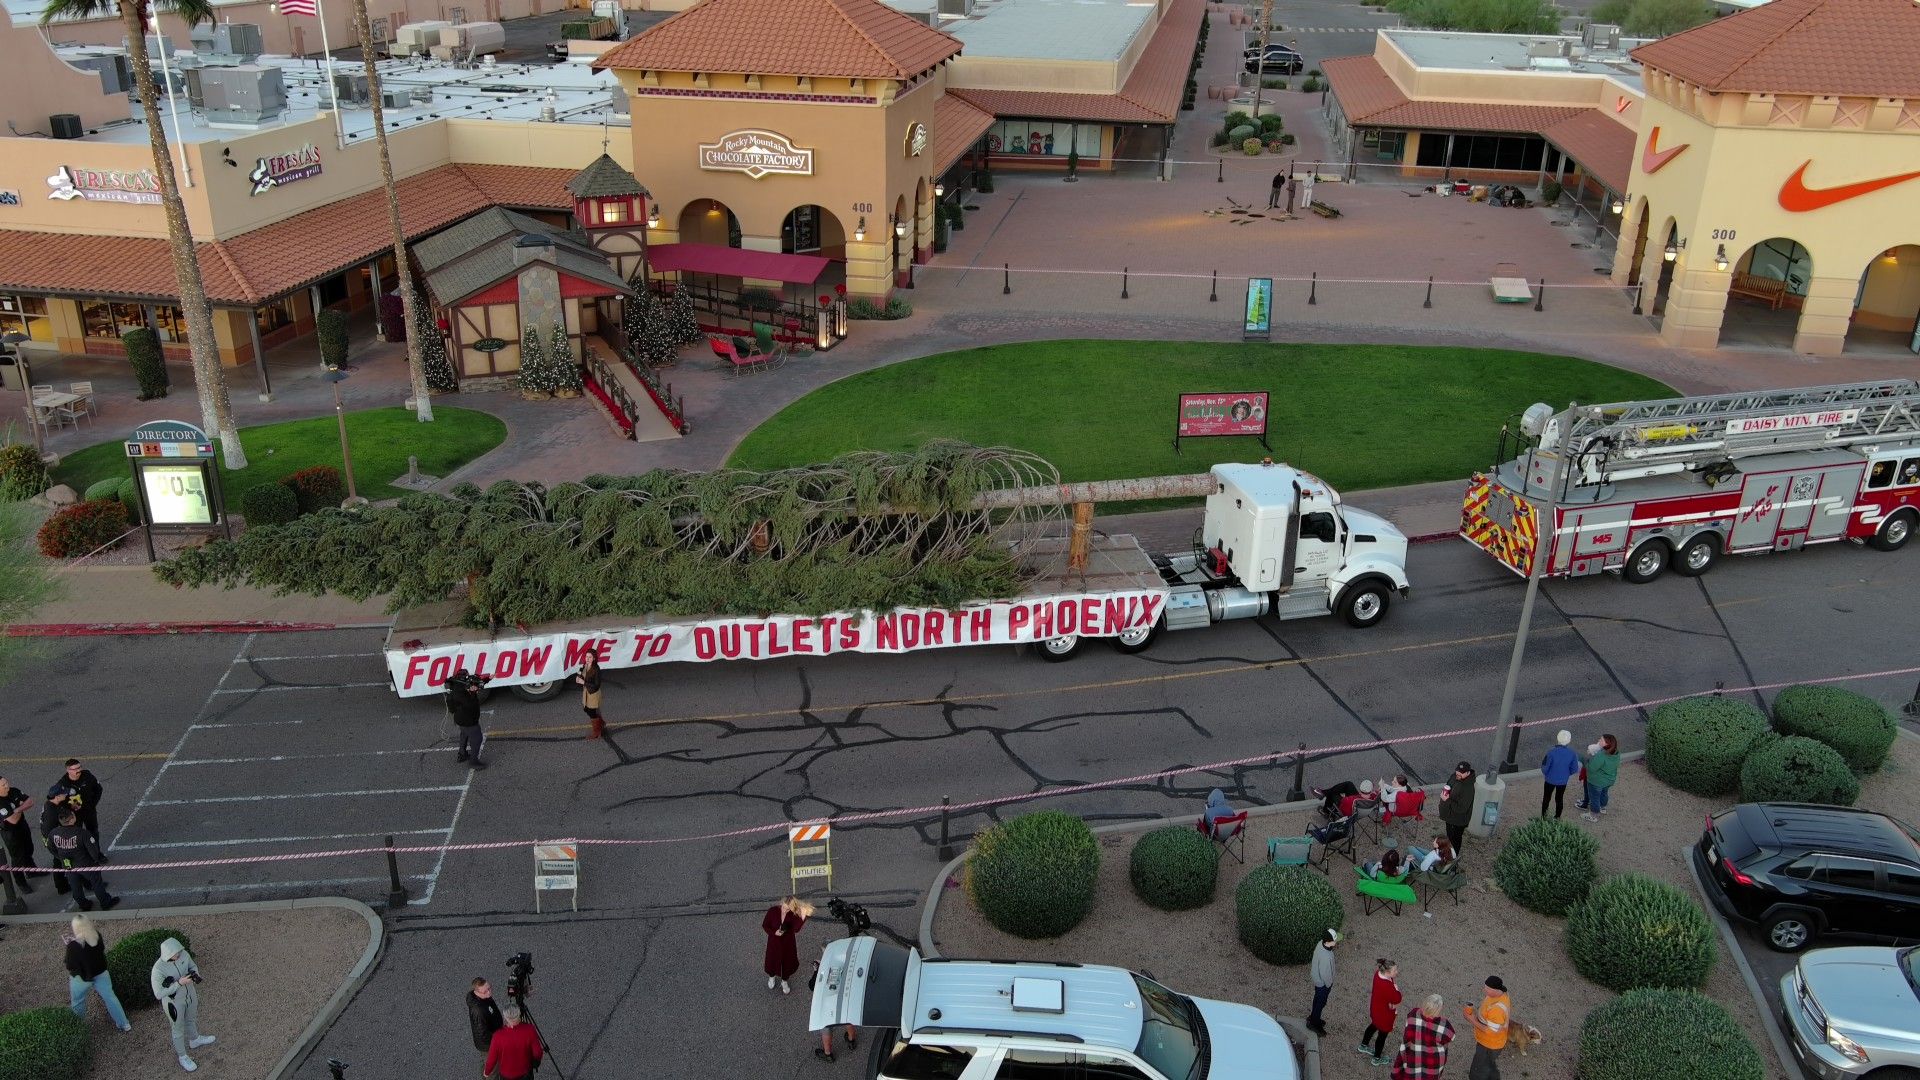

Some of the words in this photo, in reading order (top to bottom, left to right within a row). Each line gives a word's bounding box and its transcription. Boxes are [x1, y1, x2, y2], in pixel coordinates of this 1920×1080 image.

[725, 136, 748, 151] Rocky
[748, 134, 787, 155] Mountain
[268, 145, 321, 175] FRESCA'S
[706, 150, 761, 164] CHOCOLATE
[763, 154, 806, 169] FACTORY
[73, 168, 161, 192] FRESCA'S
[277, 172, 303, 184] mexican
[306, 164, 320, 178] grill
[87, 192, 129, 200] mexican
[136, 194, 161, 204] grill
[852, 202, 873, 213] 400
[1712, 229, 1736, 240] 300
[1743, 419, 1779, 431] DAISY
[1783, 415, 1812, 426] MTN.
[1817, 413, 1843, 424] FIRE
[136, 430, 197, 440] DIRECTORY
[1592, 533, 1613, 545] 145
[404, 644, 552, 690] FOLLOW
[563, 638, 618, 671] ME
[632, 633, 672, 662] TO
[694, 617, 860, 660] OUTLETS
[876, 608, 991, 650] NORTH
[1008, 594, 1162, 641] PHOENIX
[796, 866, 828, 876] UTILITIES
